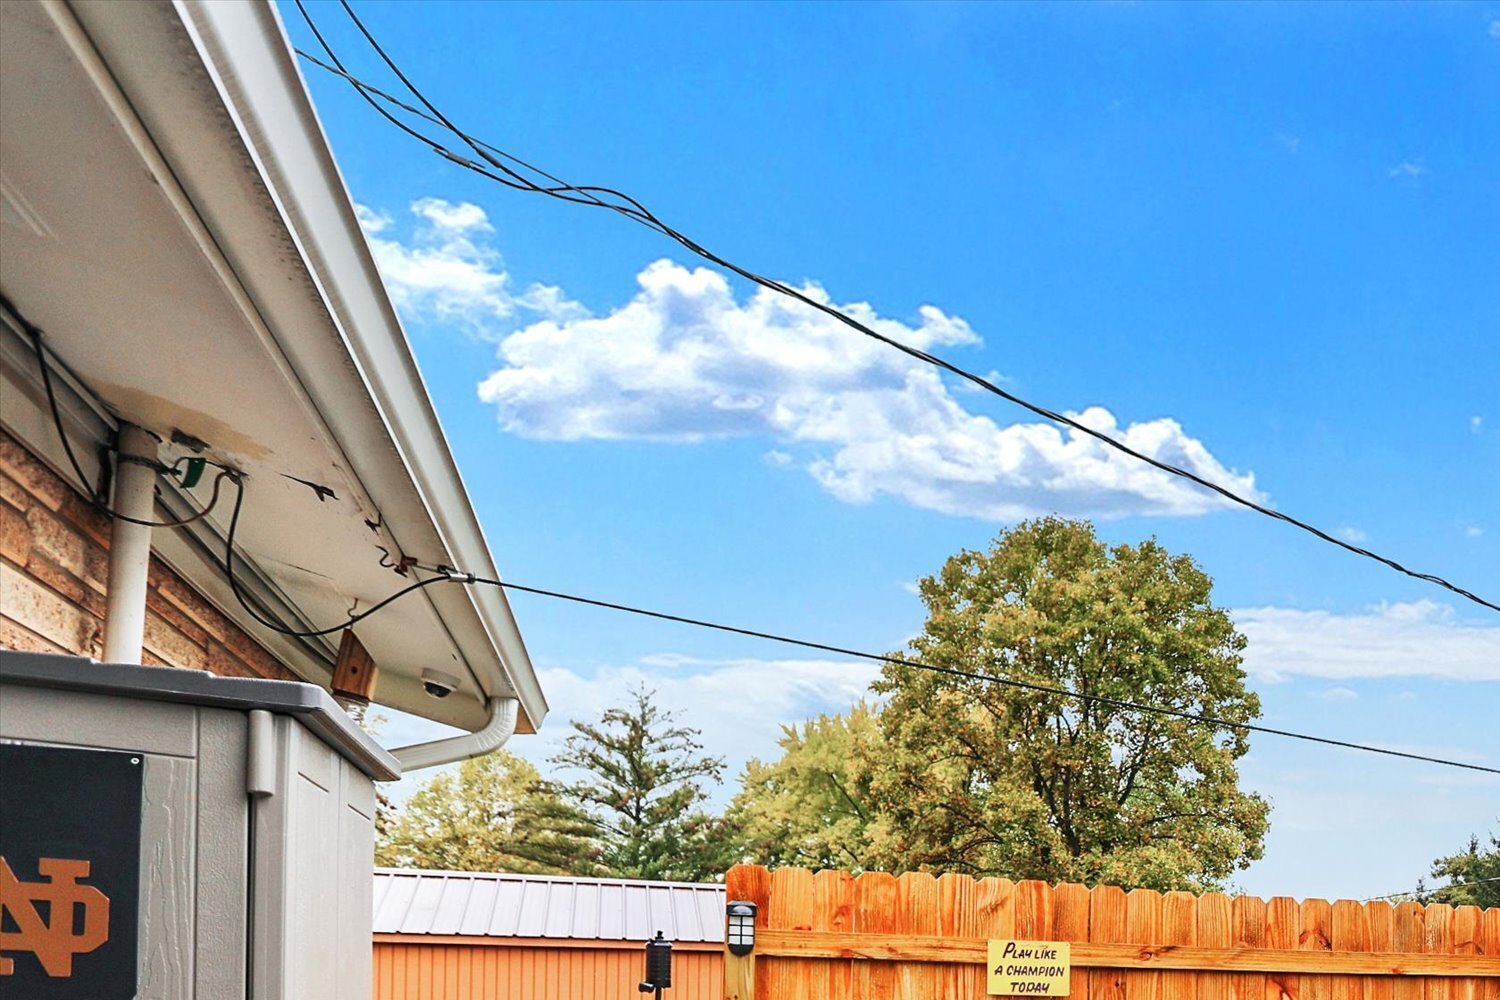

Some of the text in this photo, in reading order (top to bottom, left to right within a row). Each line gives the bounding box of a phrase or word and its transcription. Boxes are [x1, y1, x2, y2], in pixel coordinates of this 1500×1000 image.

[1002, 942, 1057, 960] PLAY LIKE
[994, 965, 1065, 977] A CHAMPION
[1010, 982, 1050, 994] TODAY
